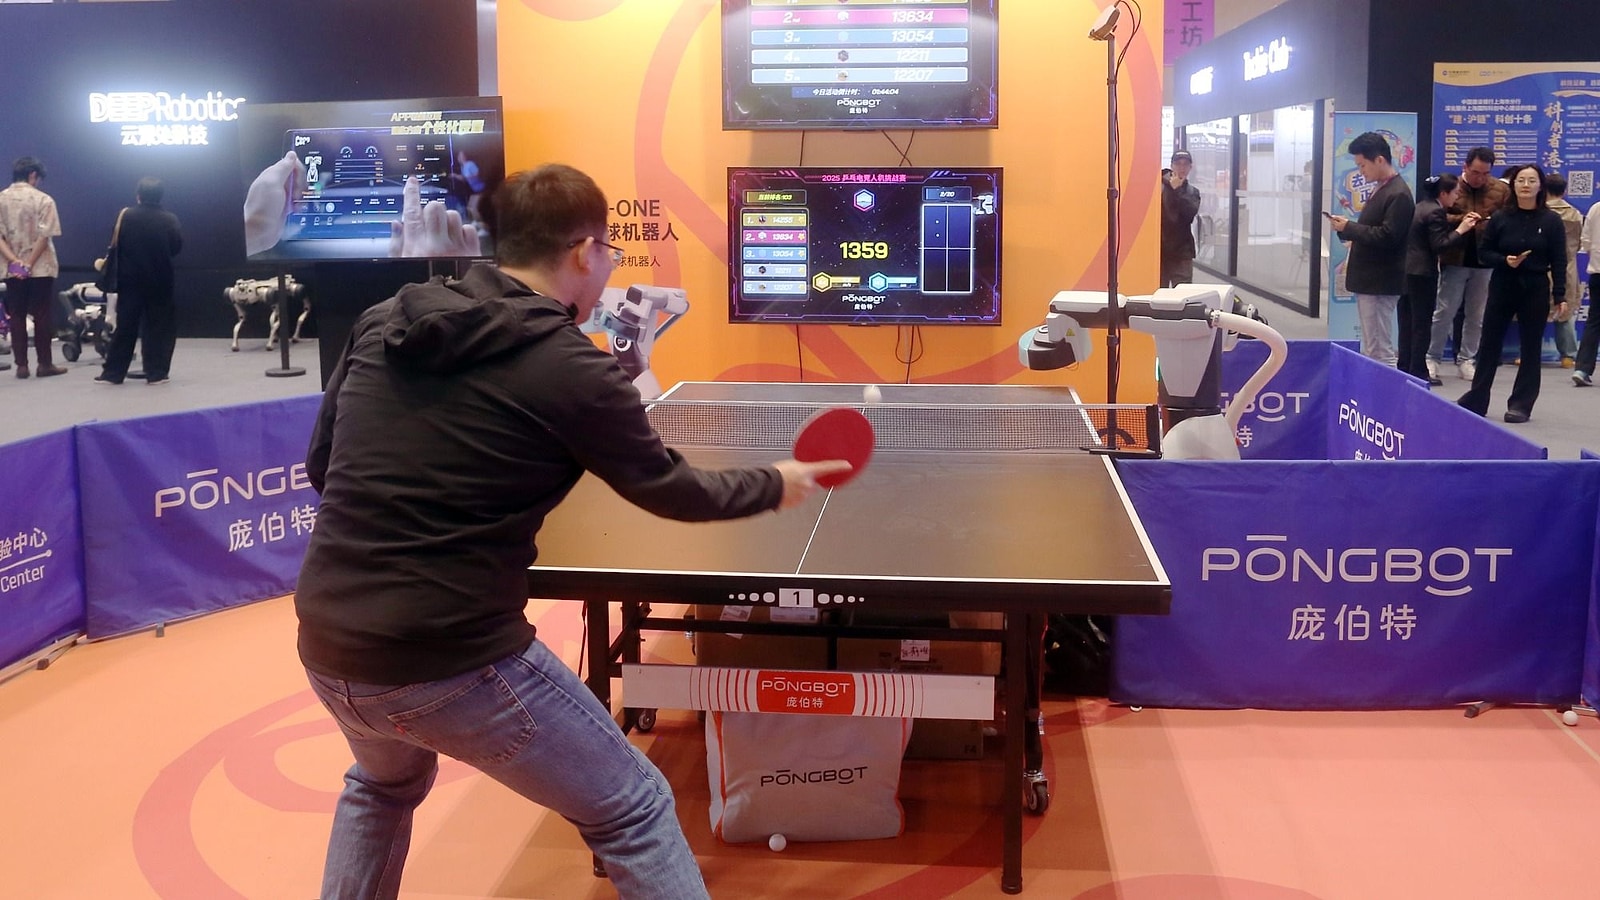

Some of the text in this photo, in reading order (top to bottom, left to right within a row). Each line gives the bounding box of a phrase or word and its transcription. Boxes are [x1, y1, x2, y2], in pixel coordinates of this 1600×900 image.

[892, 10, 934, 23] 13634
[1180, 2, 1203, 47] 工坊
[892, 30, 934, 42] 13054
[894, 69, 933, 81] 12207
[1495, 114, 1532, 125] 科创十条
[1543, 101, 1564, 175] 科创者港
[839, 242, 889, 259] 1359
[229, 504, 318, 552] 庞伯特
[0, 565, 45, 592] Center
[1287, 604, 1418, 641] 庞伯特
[786, 697, 824, 709] 庞伯特
